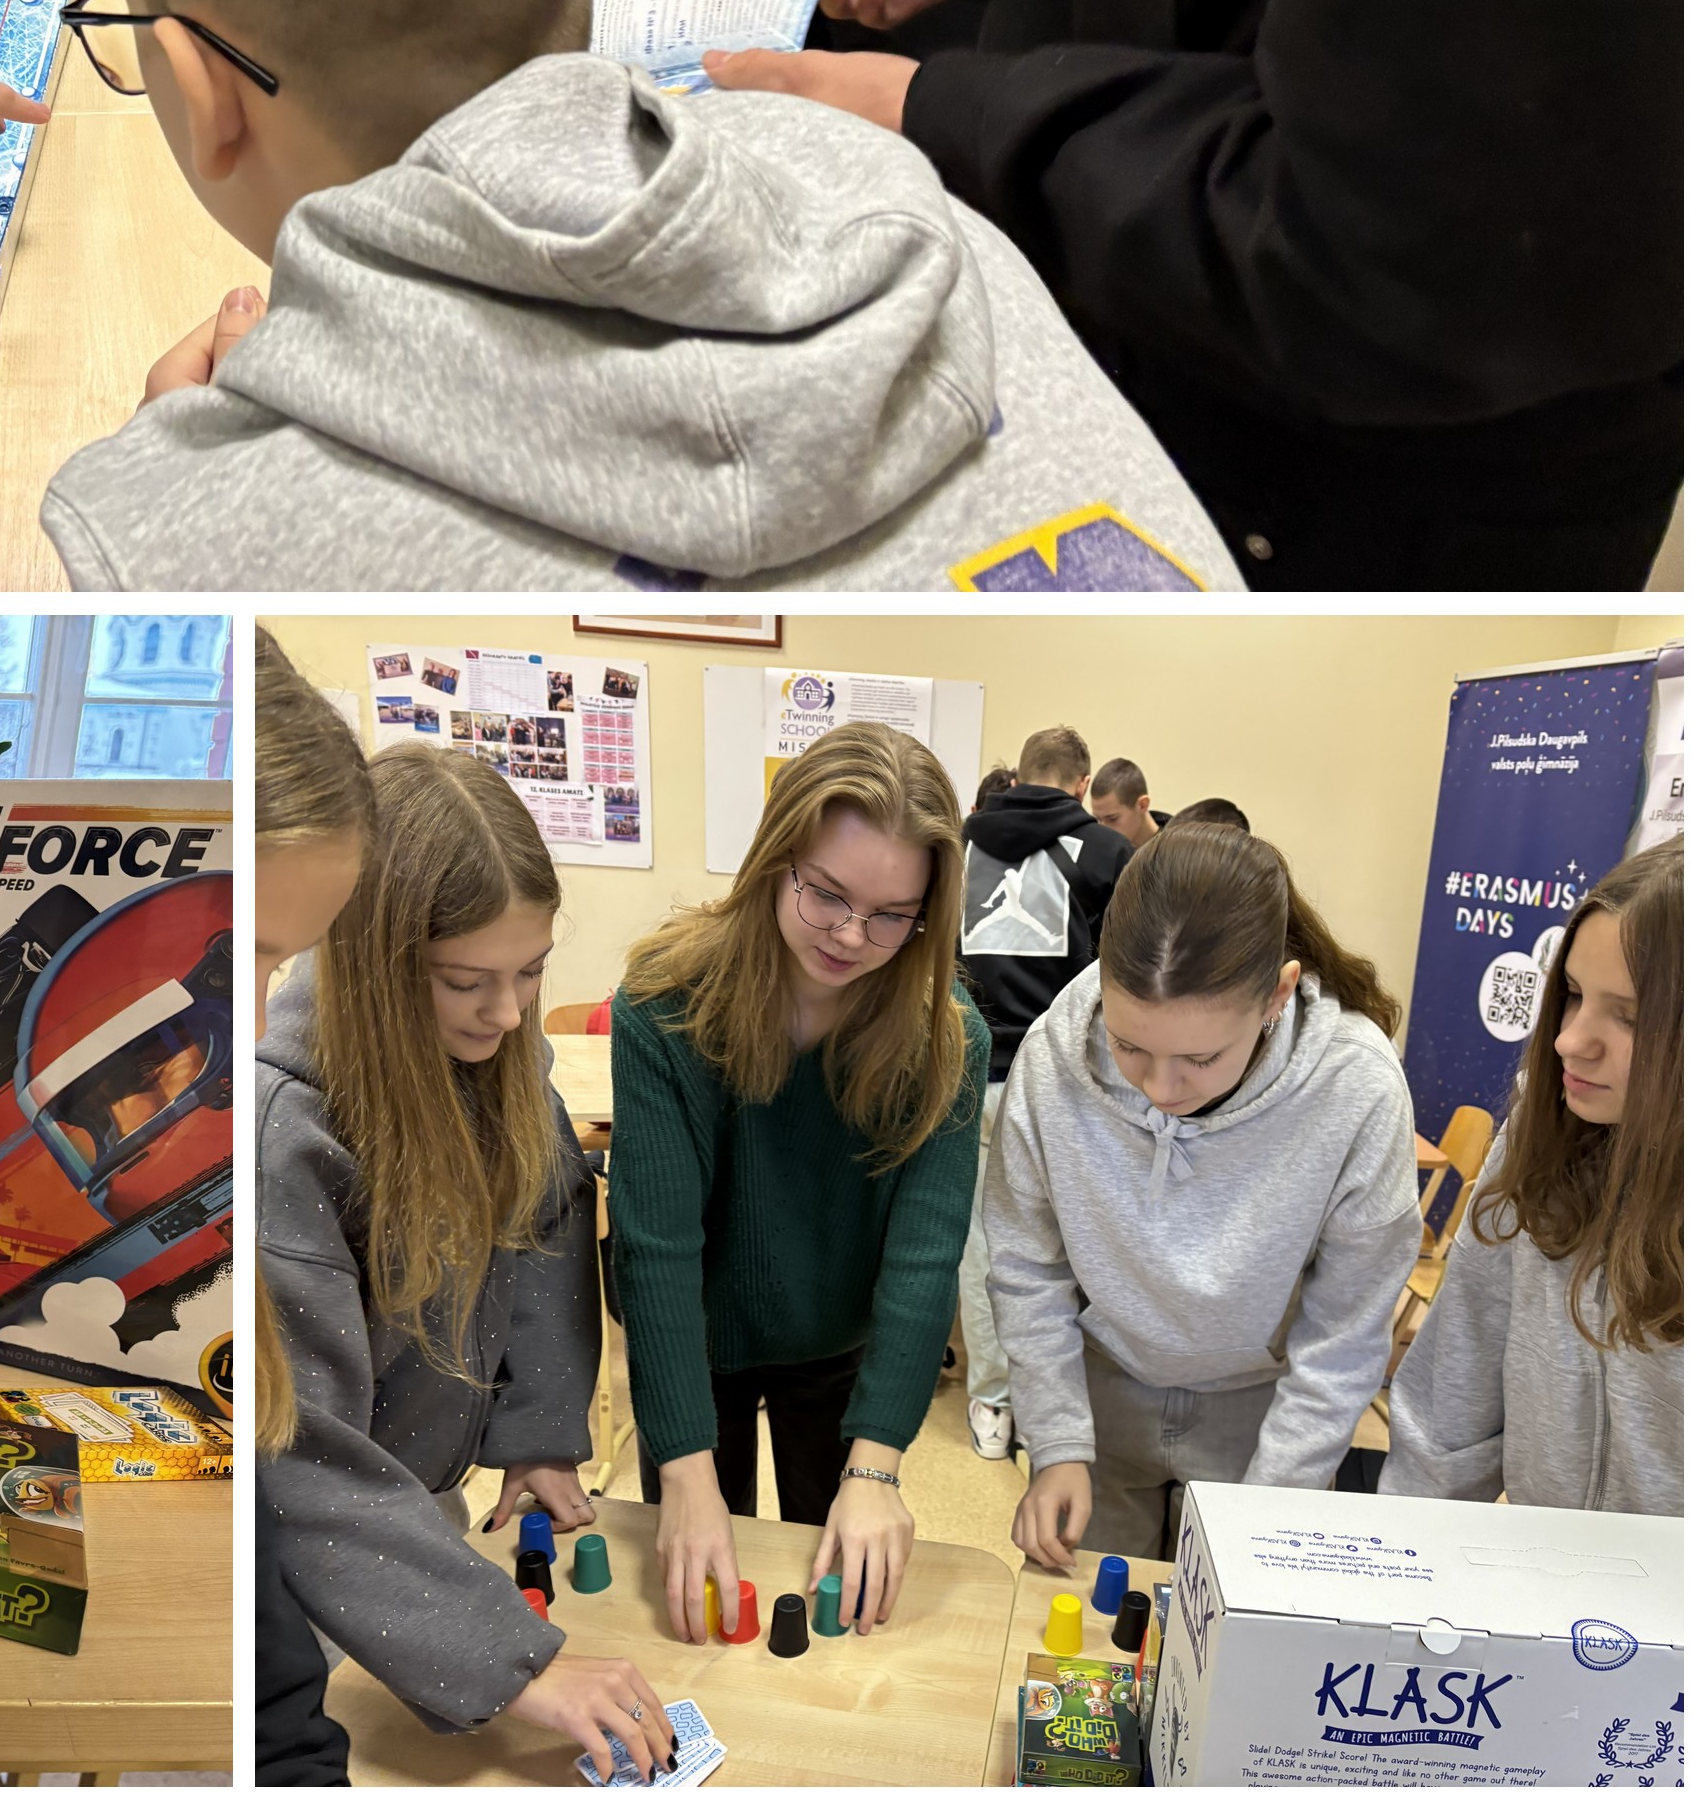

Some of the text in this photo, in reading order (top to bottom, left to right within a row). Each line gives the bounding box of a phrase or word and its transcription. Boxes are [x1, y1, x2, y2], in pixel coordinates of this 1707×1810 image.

[781, 709, 835, 726] eTwinning
[1491, 731, 1589, 750] J.Pilsudska Daugavpils
[1491, 757, 1513, 771] valsts
[1446, 870, 1577, 910] #ERASMUS
[1455, 907, 1515, 939] DAYS
[1584, 1635, 1624, 1651] KLASK
[1315, 1662, 1513, 1729] KLASK
[1352, 1732, 1475, 1746] EPIC MAGNETIC BATTLE!
[1248, 1745, 1546, 1778] Slide! Dodge! Strike! Score! The award-winning magnetic gameplay
[1267, 1758, 1487, 1785] KLASK exciting and like other game
